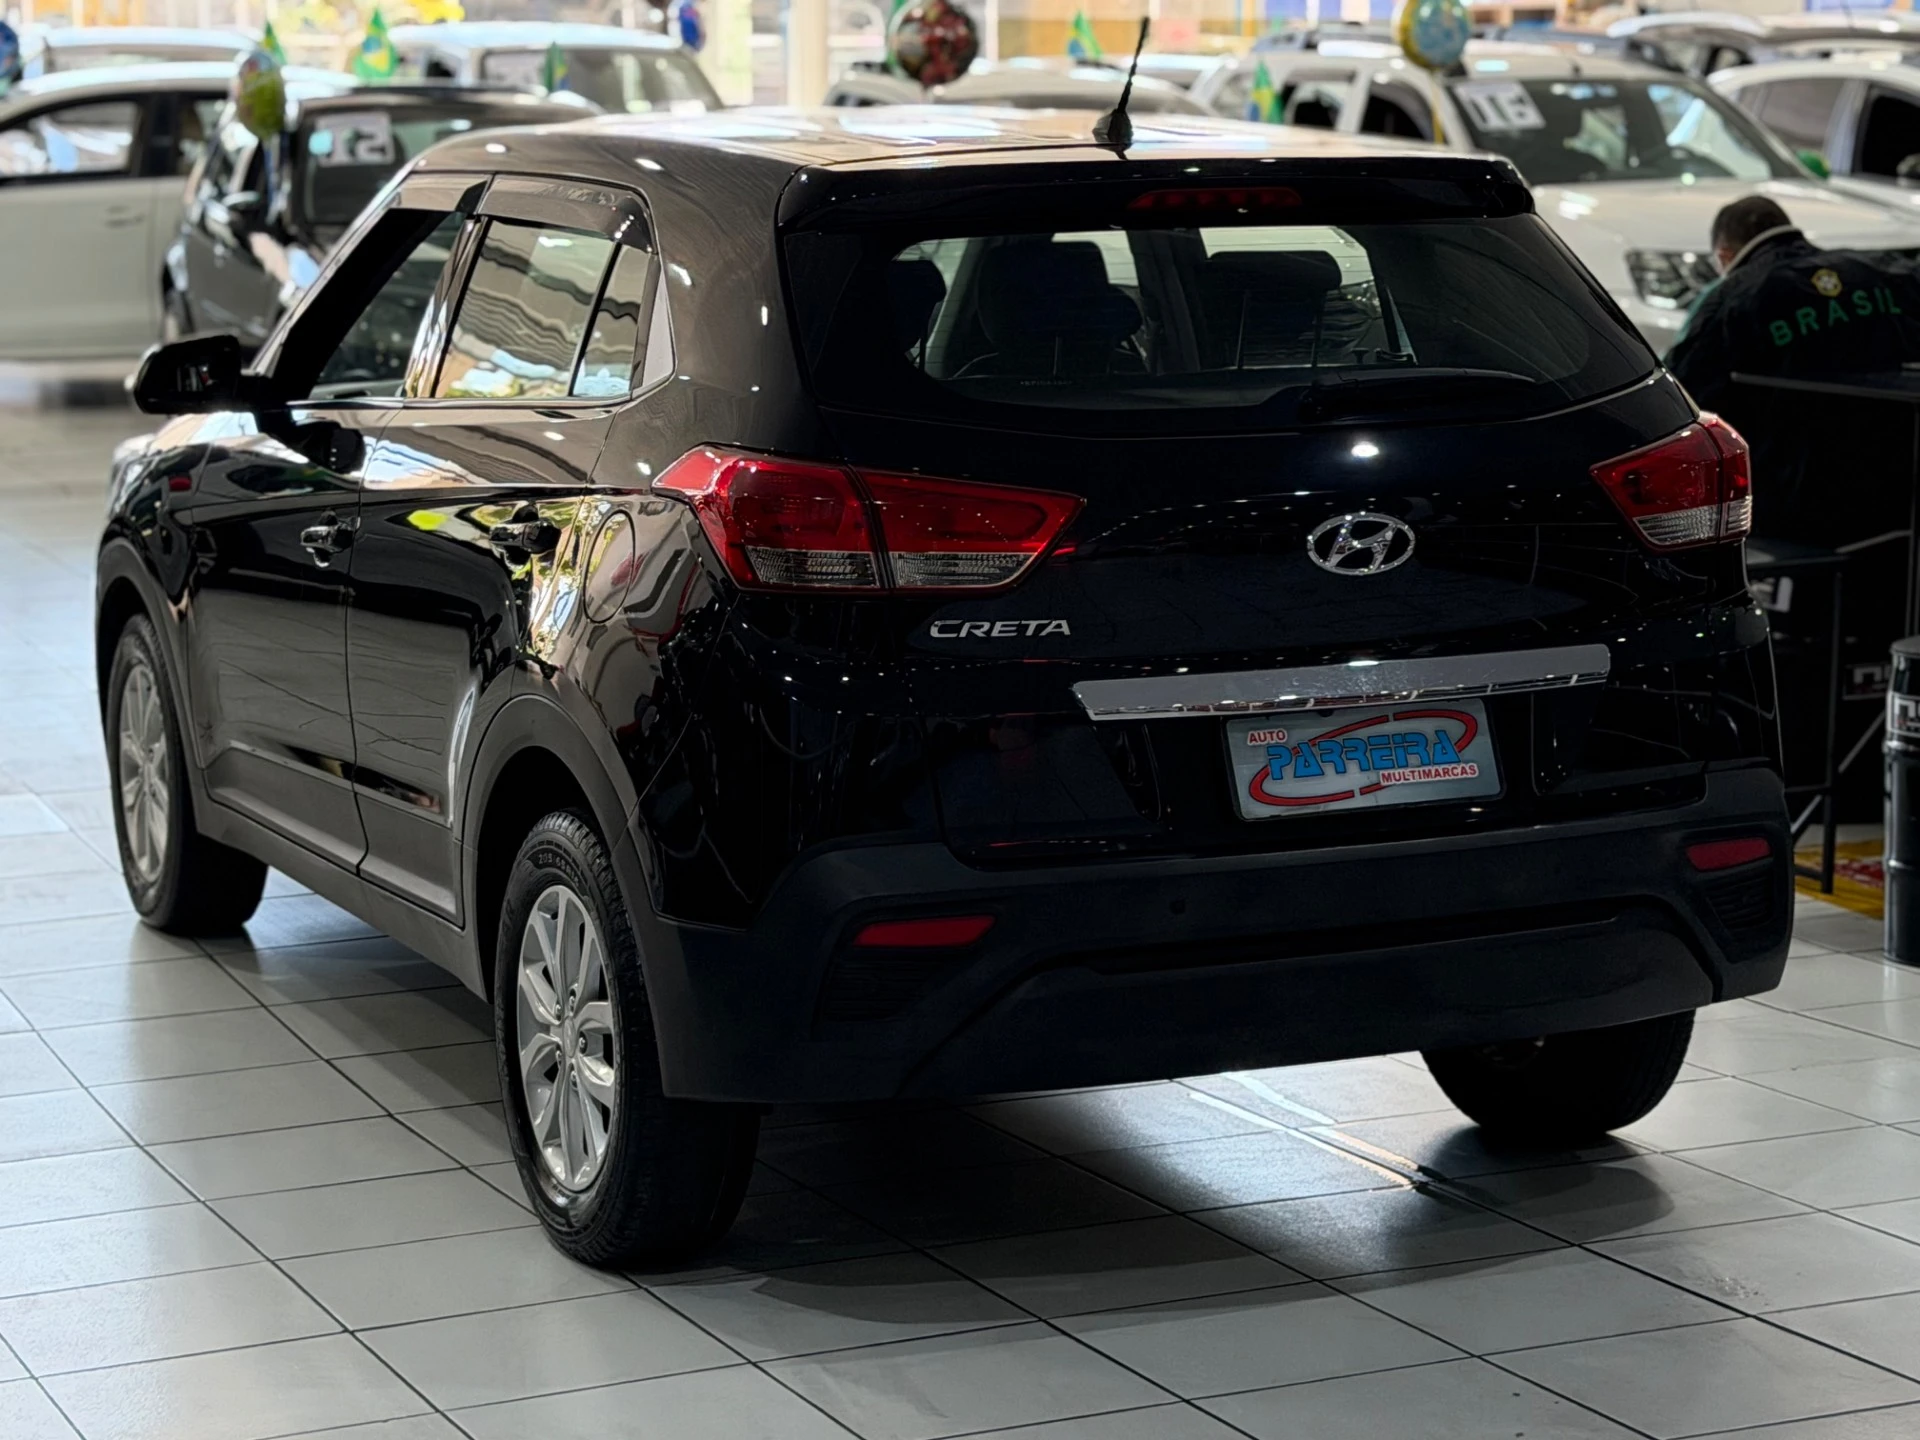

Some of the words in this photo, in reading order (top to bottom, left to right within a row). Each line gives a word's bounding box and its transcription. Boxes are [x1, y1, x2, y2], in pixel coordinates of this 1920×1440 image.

[1769, 287, 1902, 346] BRASIL
[930, 620, 1071, 638] CRETA
[1248, 730, 1286, 744] AUTO
[1381, 765, 1477, 784] MULTIMARCAS
